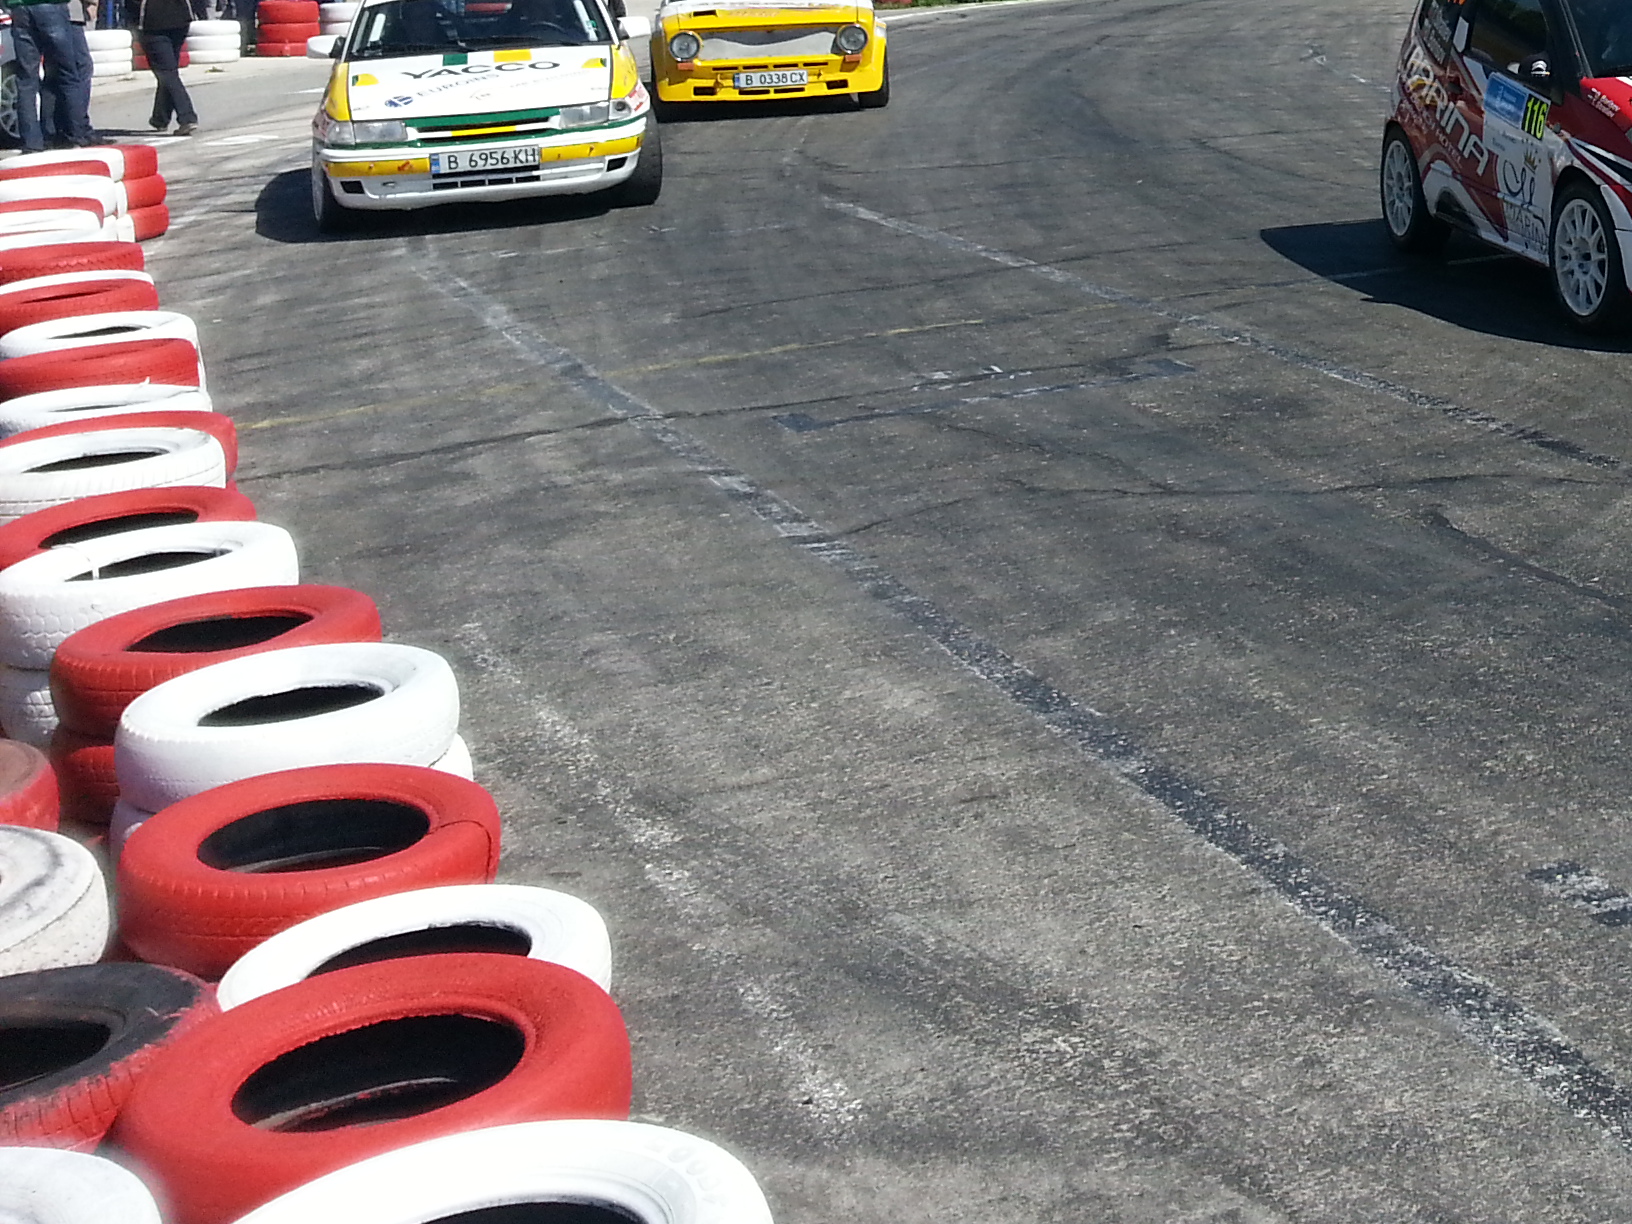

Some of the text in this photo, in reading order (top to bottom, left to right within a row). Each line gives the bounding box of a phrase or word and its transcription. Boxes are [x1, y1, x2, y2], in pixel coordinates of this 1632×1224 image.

[401, 61, 561, 79] YACCO
[745, 74, 754, 86] B
[760, 73, 788, 85] 0338
[1524, 97, 1548, 139] 116
[447, 147, 537, 170] B 6956 KH
